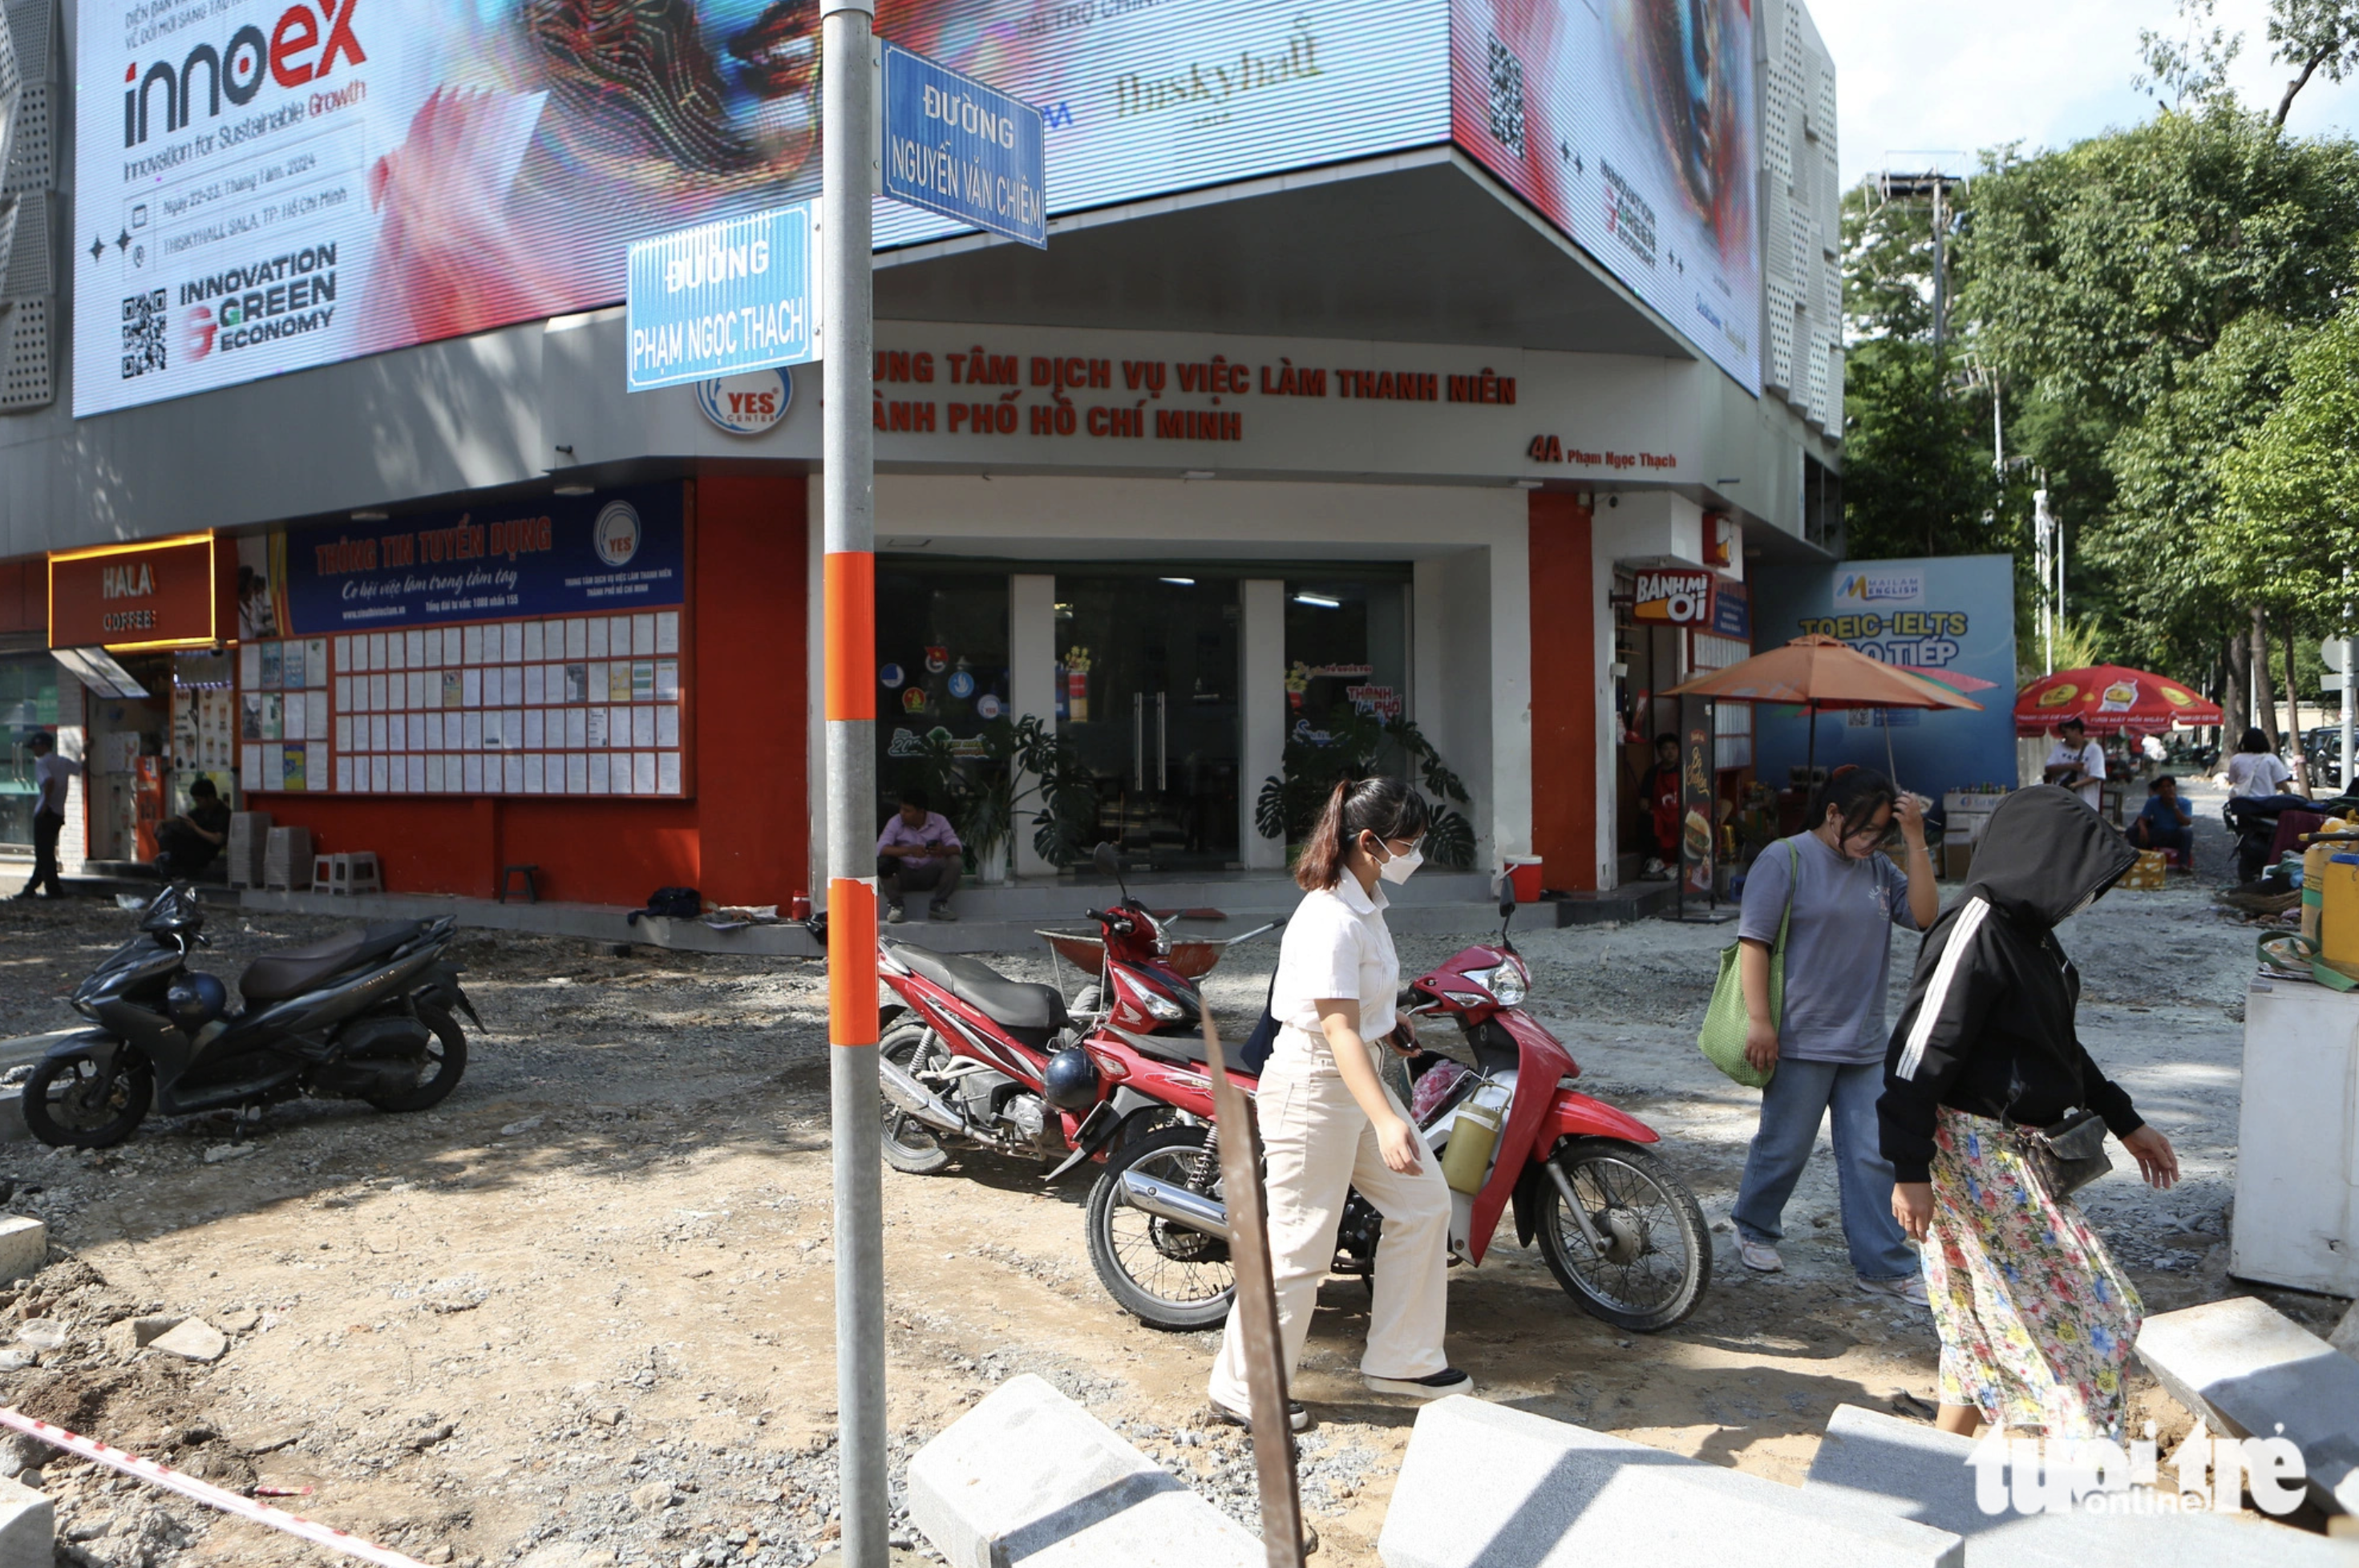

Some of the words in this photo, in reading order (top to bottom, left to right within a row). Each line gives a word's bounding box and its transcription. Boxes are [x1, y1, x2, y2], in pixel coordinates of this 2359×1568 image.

[195, 133, 215, 158] for
[219, 102, 305, 149] Sustainable
[309, 79, 366, 118] Growth
[923, 83, 1014, 150] ĐƯỜNG
[319, 186, 348, 209] Minh
[892, 134, 958, 200] NGUYỄN
[963, 154, 993, 212] VĂN
[996, 174, 1041, 229] CHIÊM
[180, 241, 337, 305] INNOVATION
[220, 270, 336, 328] GREEN
[221, 305, 336, 352] ECONOMY
[633, 321, 683, 375] PHẠM
[688, 310, 738, 366] NGỌC
[740, 296, 803, 357] THẠCH
[872, 350, 933, 384] UNG
[946, 345, 1018, 386] TÂM
[1031, 356, 1111, 394] DỊCH
[1122, 360, 1166, 399] VỤ
[1178, 354, 1250, 405] VIỆC
[1260, 358, 1327, 398] LÀM
[1336, 369, 1438, 402] THANH
[1448, 366, 1516, 406] NIÊN
[727, 391, 775, 414] YES
[727, 414, 775, 422] CENTER
[872, 389, 936, 433] ÀNH
[947, 389, 1022, 434] PHỐ
[1030, 391, 1077, 438] HỒ
[1086, 400, 1144, 438] CHÍ
[1156, 407, 1242, 442] MINH
[1528, 434, 1563, 463] 4A
[1567, 449, 1602, 467] Phạm
[1605, 451, 1636, 470] Ngọc
[1639, 452, 1677, 471] Thạch
[315, 534, 377, 576] THÔNG
[381, 532, 415, 568] TIN
[419, 512, 485, 565] TUYỂN
[490, 515, 552, 561] DỤNG
[609, 536, 632, 553] YES
[103, 563, 153, 599] HALA
[403, 573, 427, 593] làm
[429, 574, 463, 596] trong
[495, 567, 518, 591] tay
[1636, 572, 1686, 603] BÁNH
[1867, 578, 1919, 587] MAILAM
[1867, 586, 1919, 596] ENGLISH
[507, 594, 519, 606] 155
[103, 610, 152, 632] COFFEE
[1799, 611, 1968, 639] TOEIC-IELTS
[1887, 635, 1958, 666] TIẾP
